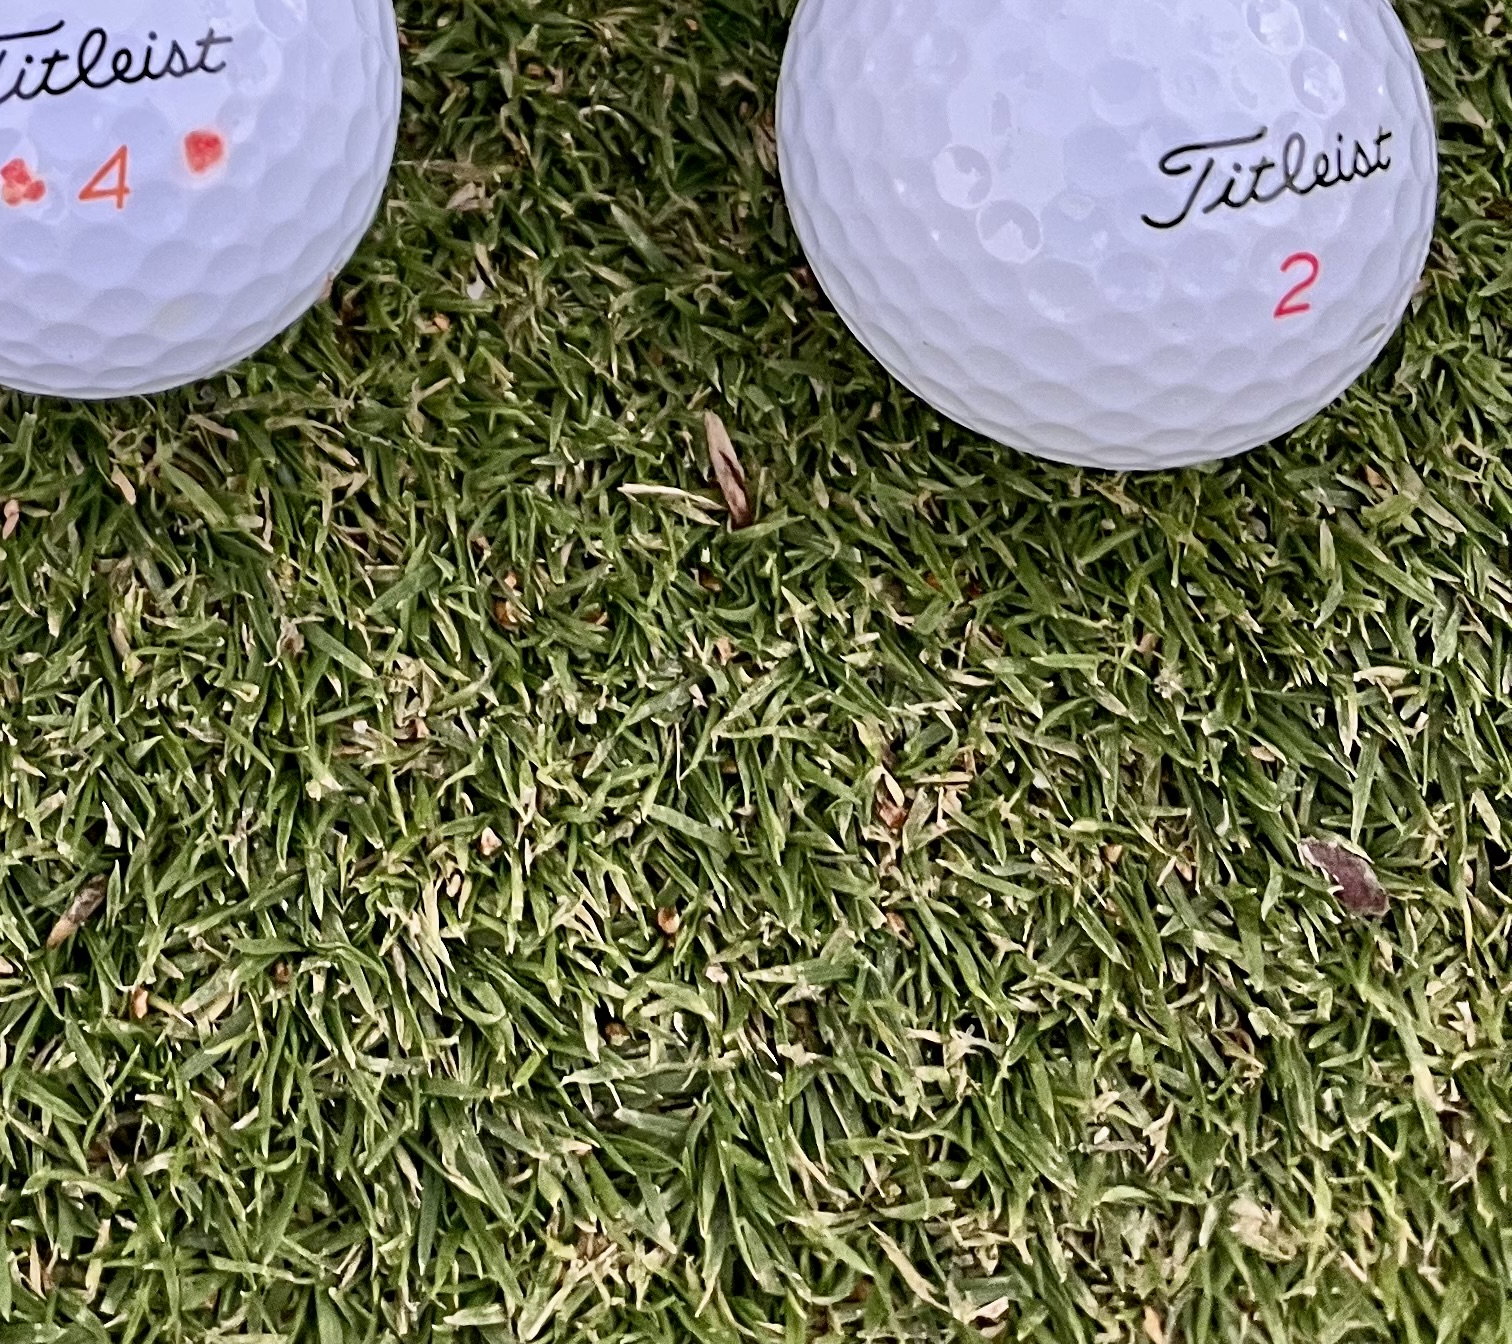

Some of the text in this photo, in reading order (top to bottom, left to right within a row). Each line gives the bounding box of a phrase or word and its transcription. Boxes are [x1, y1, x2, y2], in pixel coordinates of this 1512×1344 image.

[78, 144, 131, 210] 4
[1141, 125, 1394, 230] Titleist
[1273, 251, 1321, 320] 2
